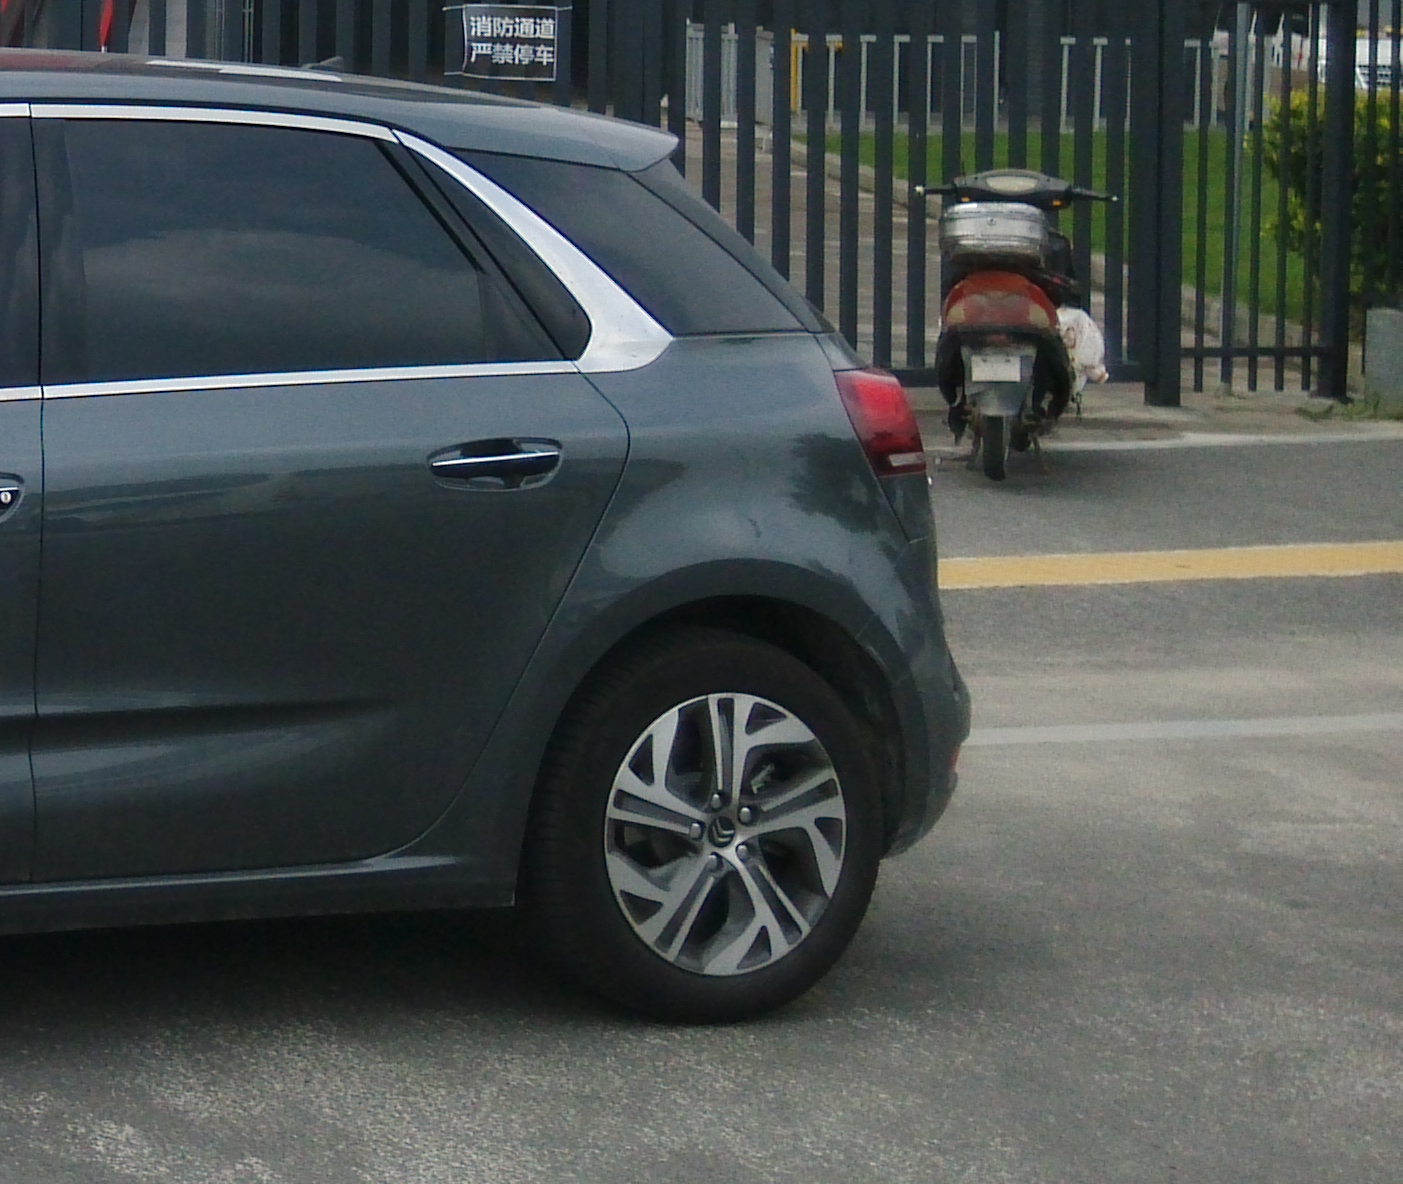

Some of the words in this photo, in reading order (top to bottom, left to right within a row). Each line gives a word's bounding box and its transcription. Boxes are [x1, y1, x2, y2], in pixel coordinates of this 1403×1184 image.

[469, 15, 556, 40] 消防通道
[470, 42, 555, 66] 严禁停车
